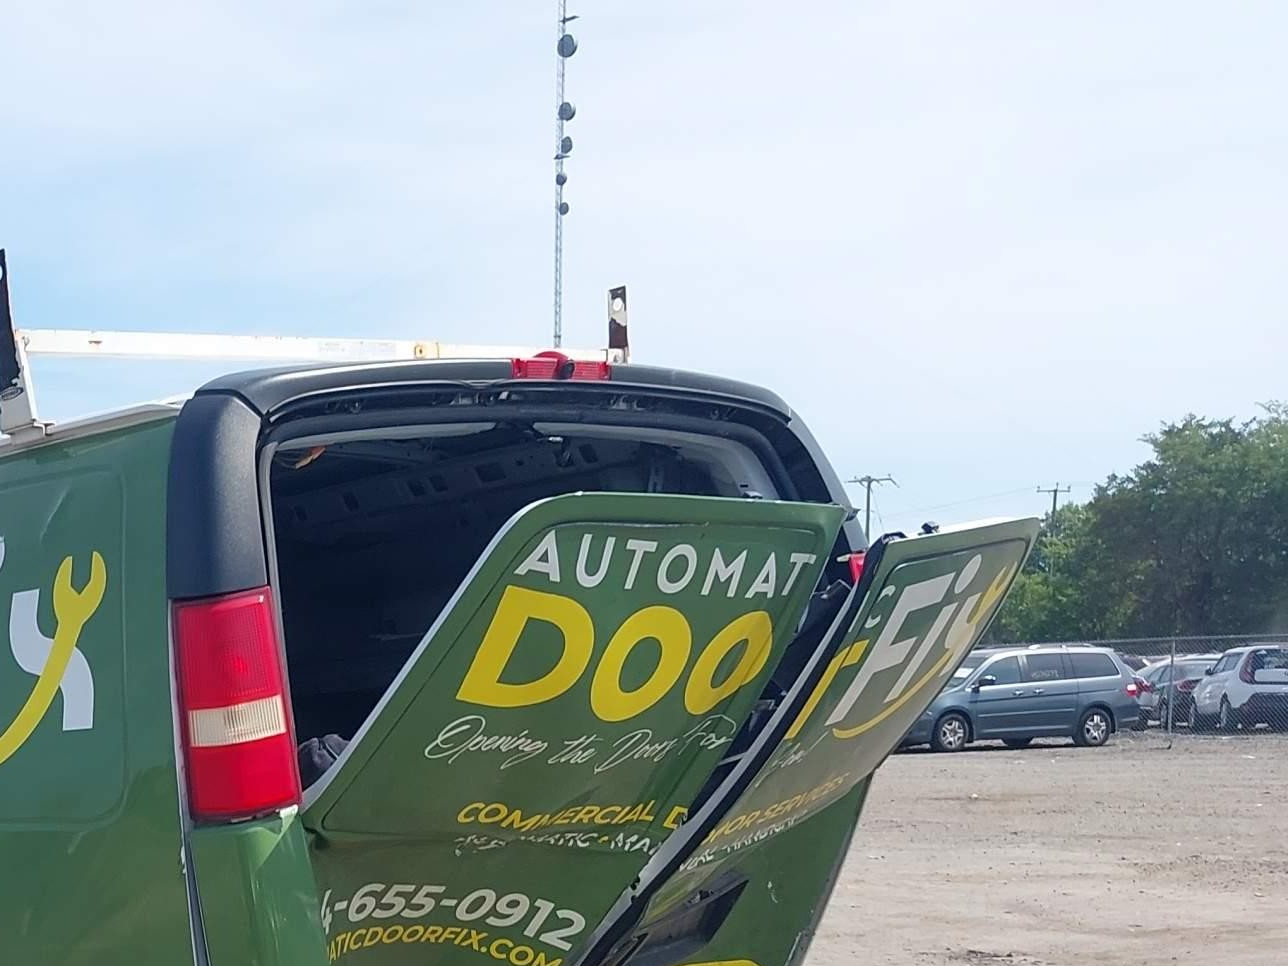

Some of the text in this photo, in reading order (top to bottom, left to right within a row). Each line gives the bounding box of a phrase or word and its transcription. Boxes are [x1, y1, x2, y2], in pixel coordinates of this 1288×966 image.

[514, 529, 816, 599] AUTOMAT
[424, 715, 548, 771] Opening
[548, 733, 599, 765] the
